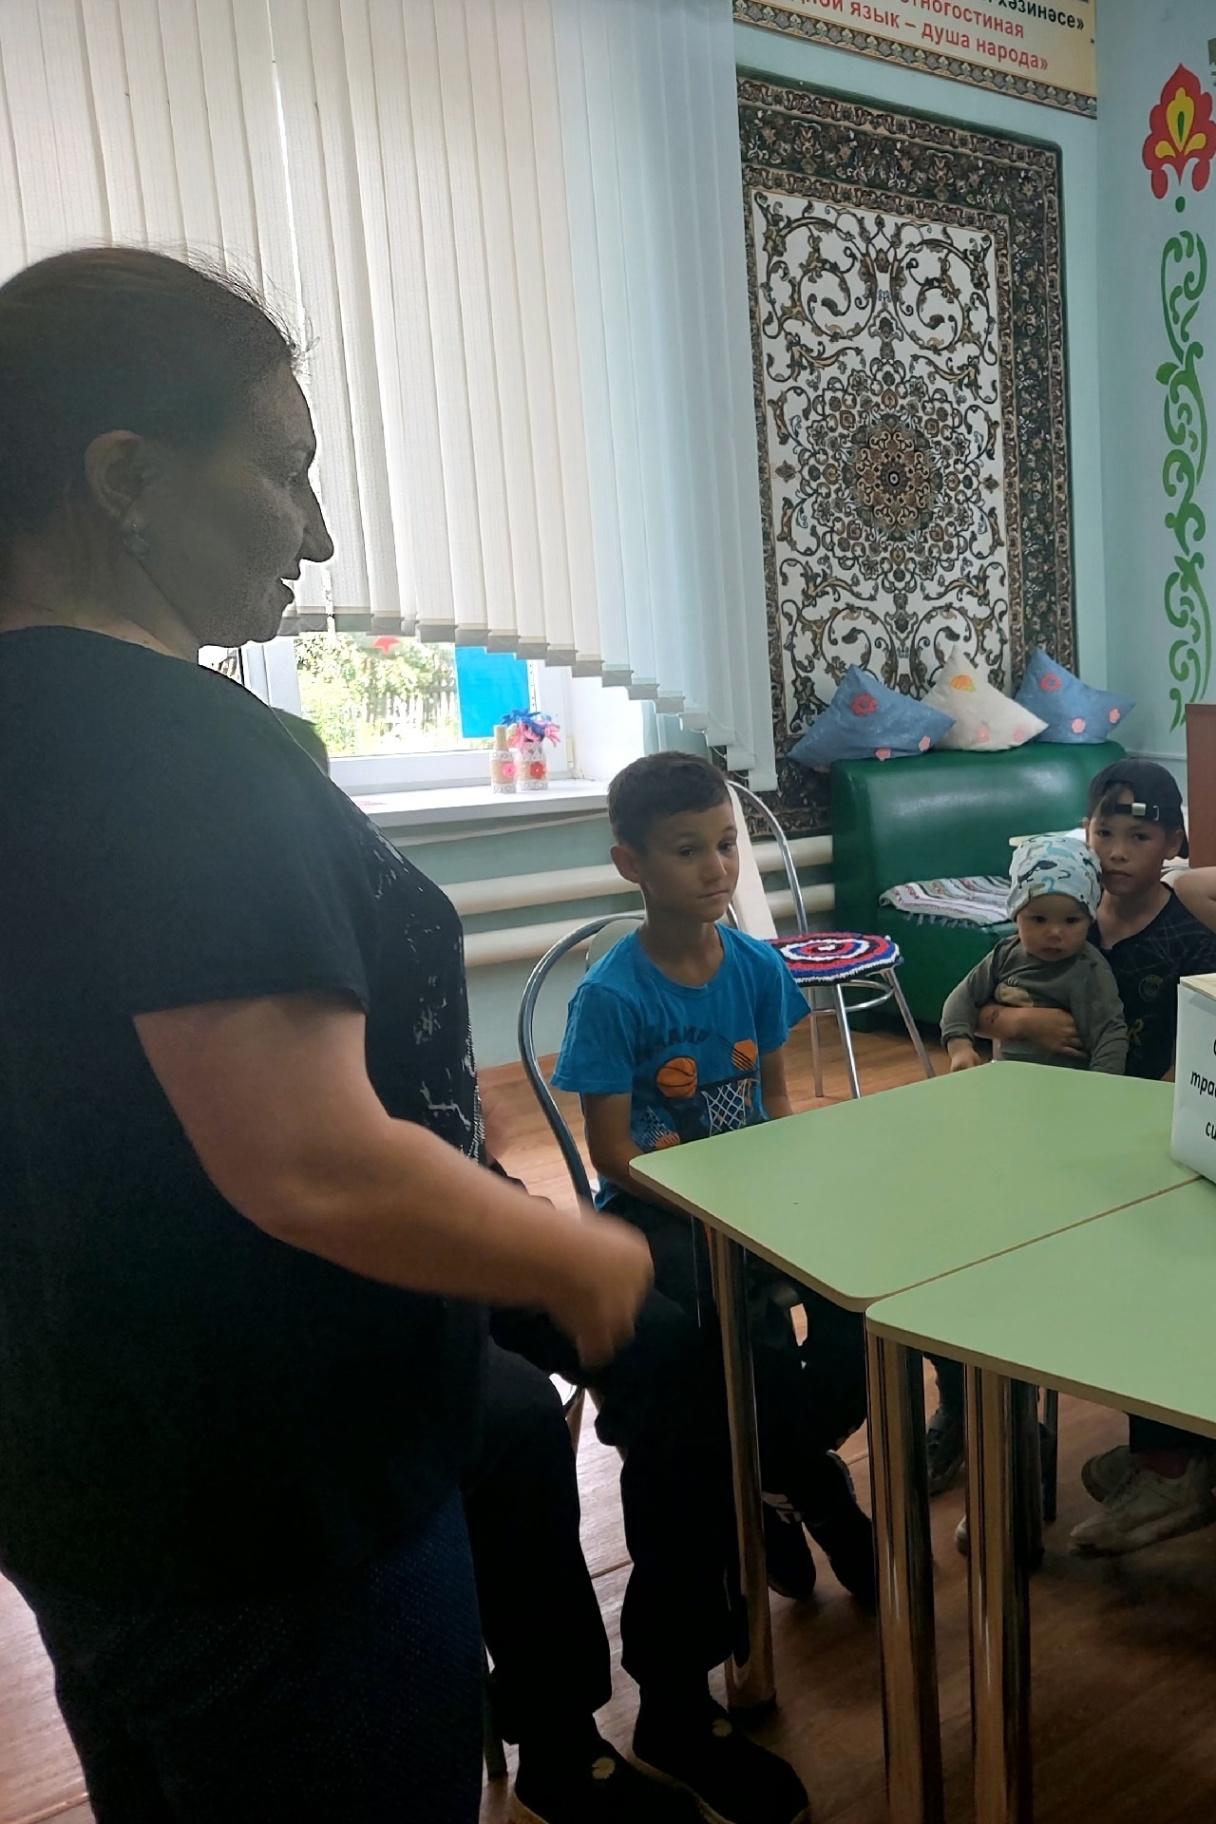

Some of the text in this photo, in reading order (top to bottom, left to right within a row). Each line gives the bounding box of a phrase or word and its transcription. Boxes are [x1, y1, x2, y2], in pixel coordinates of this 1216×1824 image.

[850, 2, 900, 29] язык
[921, 22, 970, 49] душа
[976, 38, 1048, 71] народа»
